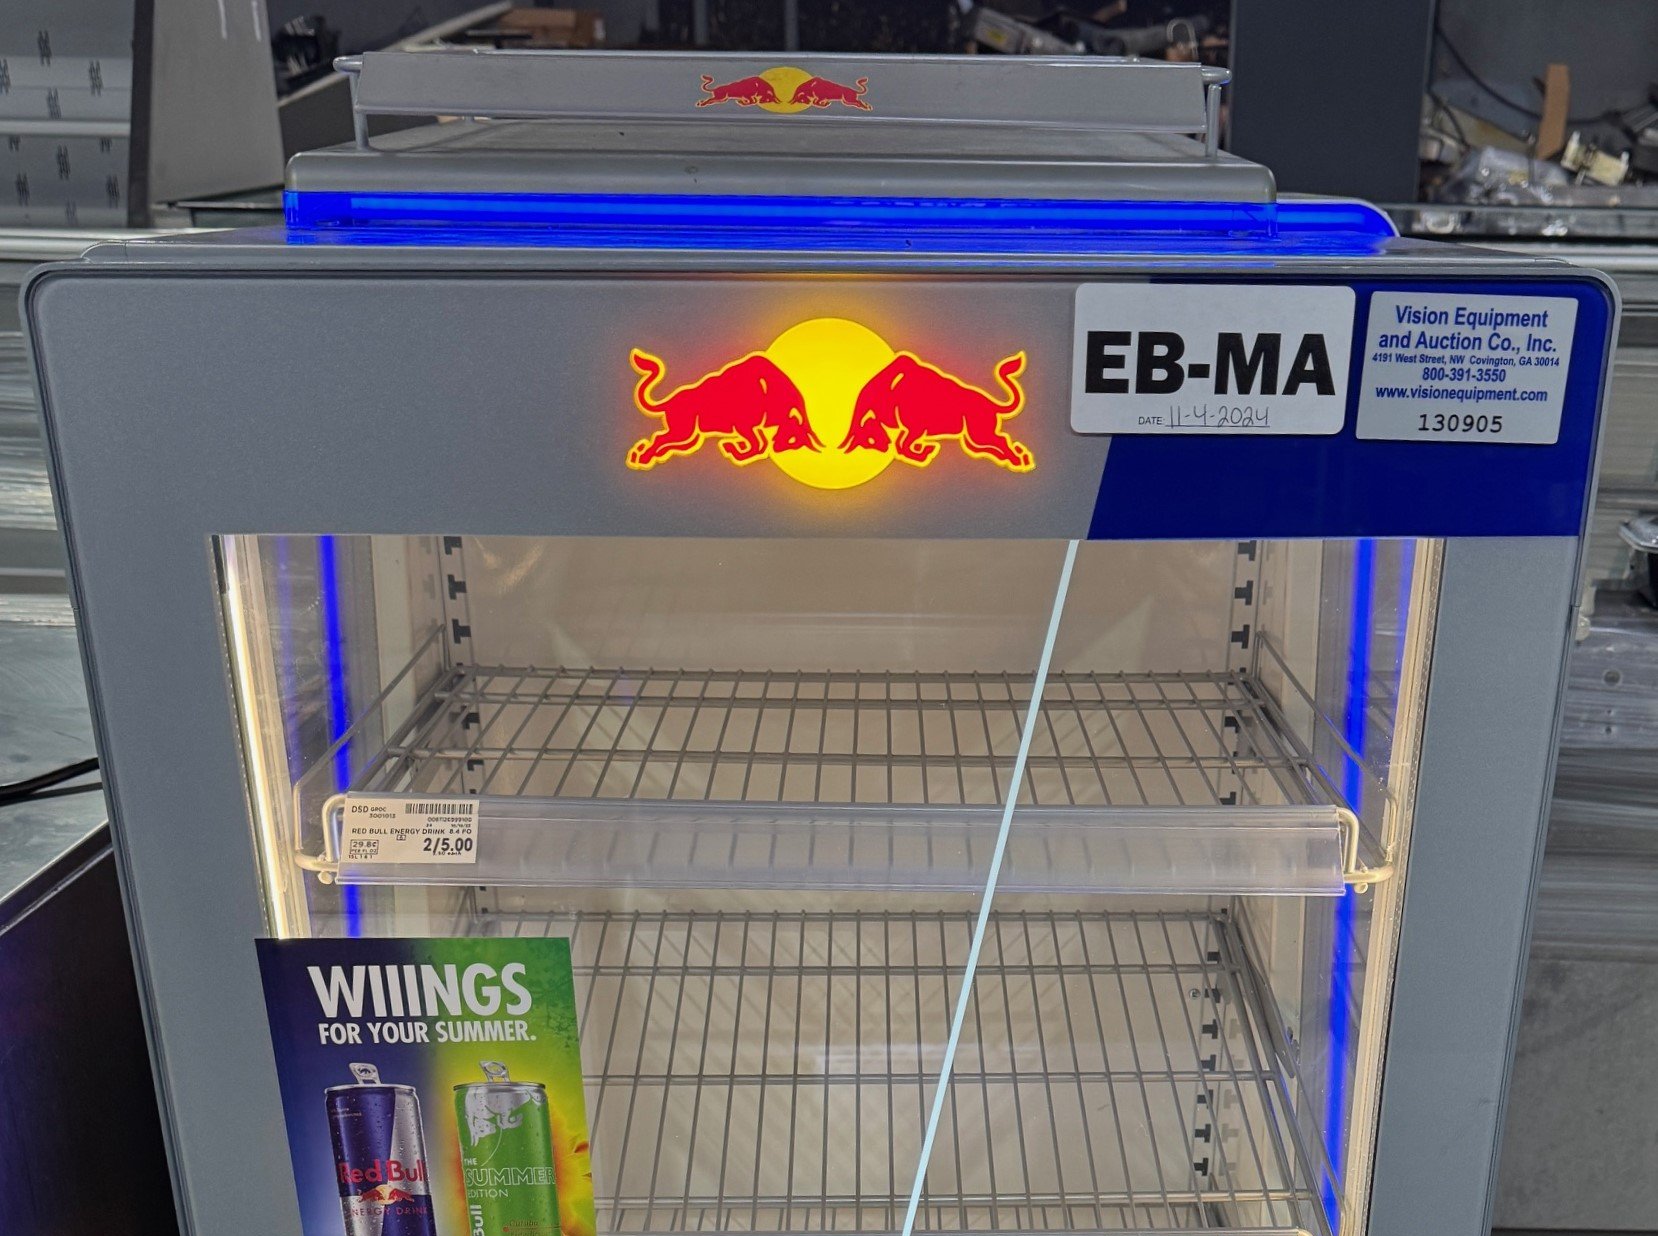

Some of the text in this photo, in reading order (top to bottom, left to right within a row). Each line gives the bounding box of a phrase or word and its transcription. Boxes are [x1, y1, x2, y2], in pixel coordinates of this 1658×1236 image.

[1395, 305, 1548, 331] Vision Equipment
[1378, 331, 1557, 354] and Auction Co., Inc.
[1085, 330, 1336, 396] EB-MA
[1372, 353, 1560, 367] 4191 West Street, NW Covington, GA 30014
[1422, 367, 1507, 382] 800-391-3550
[1375, 385, 1548, 403] www.visionequipment.com
[1138, 416, 1164, 425] DATE:
[1169, 404, 1270, 429] 11-4-2024
[1418, 413, 1503, 433] 130905
[351, 805, 369, 813] DSD
[423, 837, 473, 855] 2/5.00
[307, 962, 532, 1018] WIIINGS
[318, 1020, 537, 1045] FOR YOUR SUMMER.
[338, 1158, 427, 1183] Red Bull
[466, 1167, 556, 1186] SUMMER
[468, 1188, 509, 1199] EDITION
